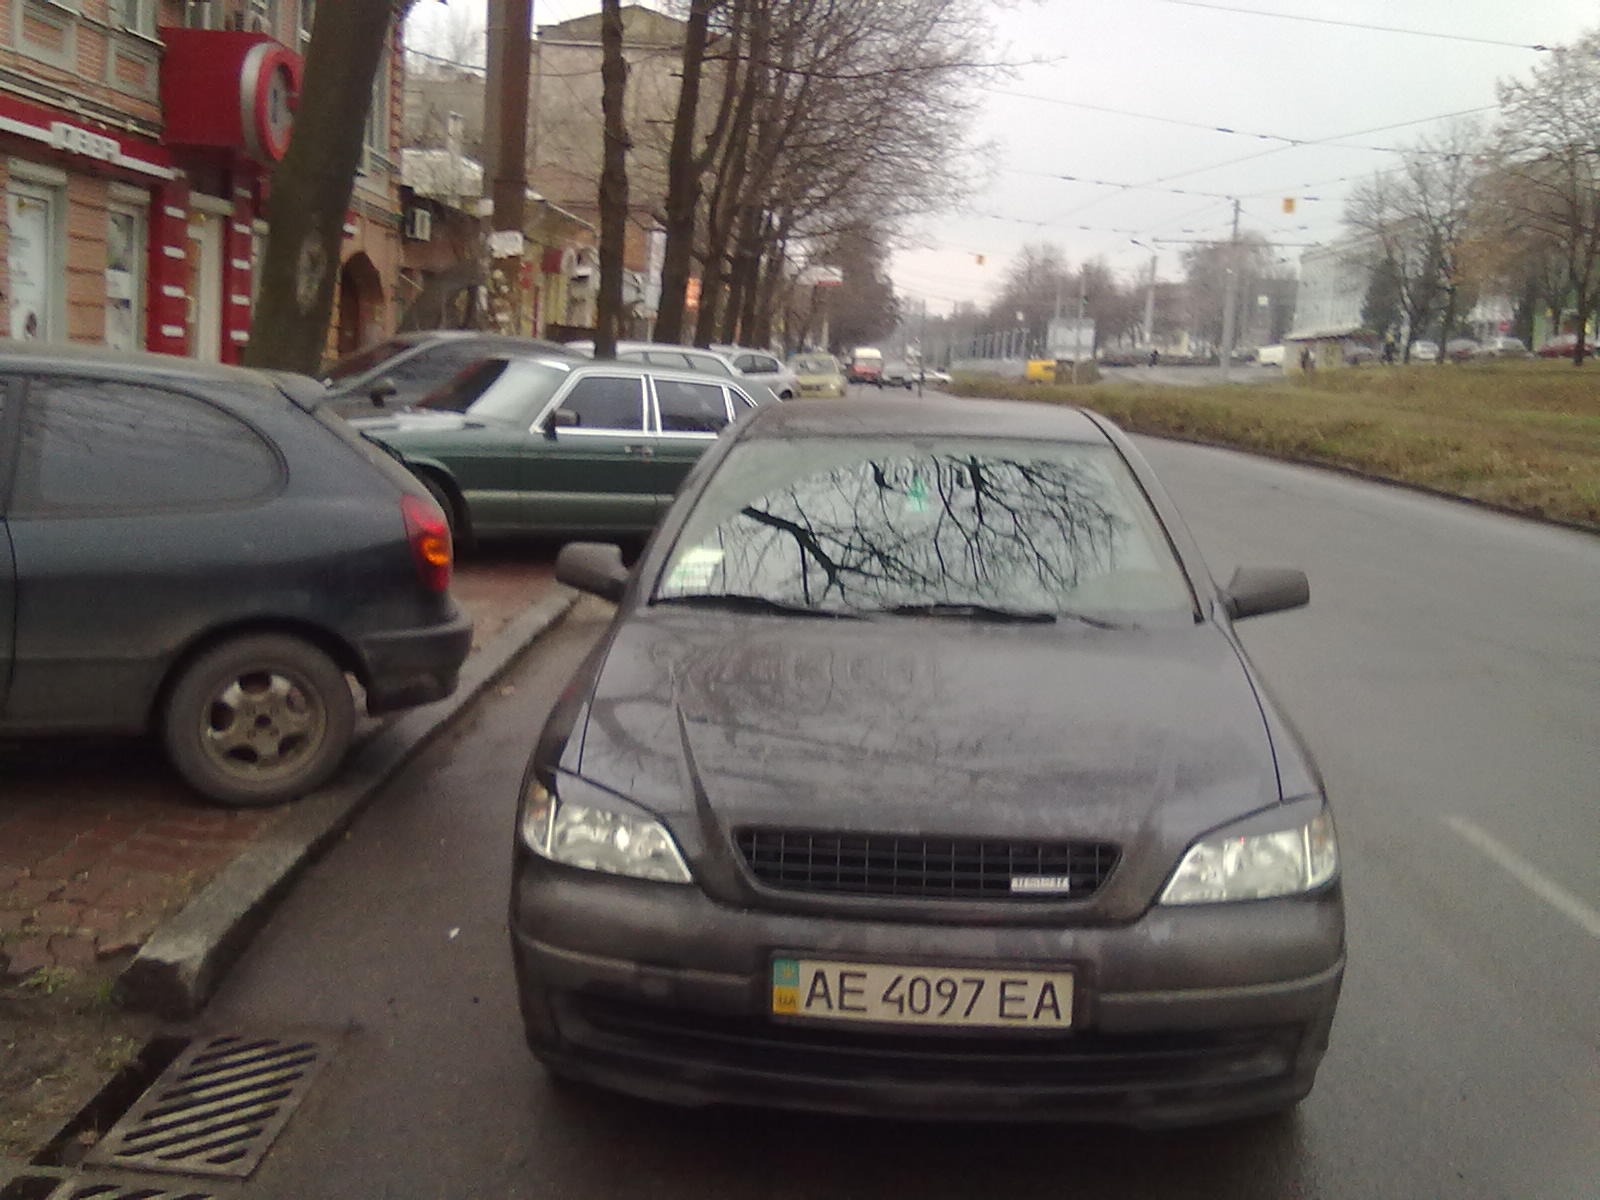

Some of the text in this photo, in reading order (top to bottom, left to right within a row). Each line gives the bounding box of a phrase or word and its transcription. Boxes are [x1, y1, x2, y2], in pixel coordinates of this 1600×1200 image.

[804, 968, 1062, 1021] AE 4097 EA
